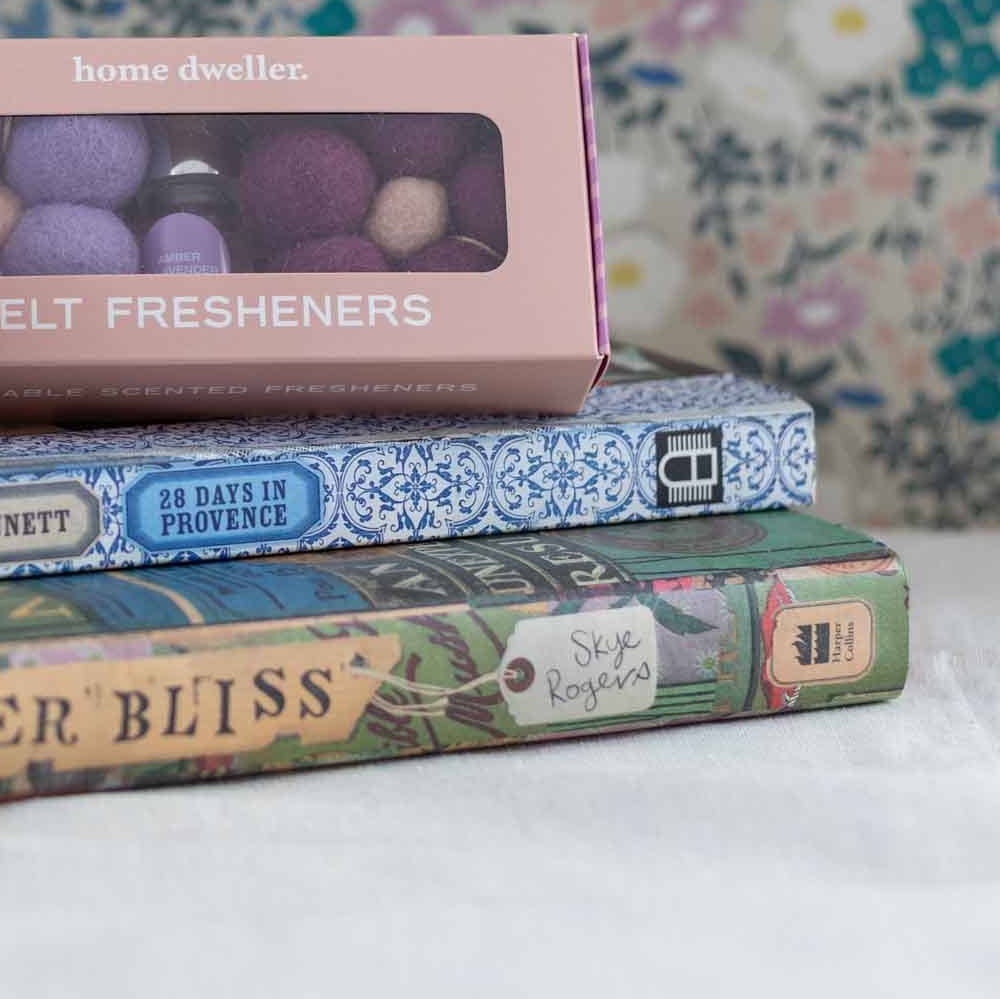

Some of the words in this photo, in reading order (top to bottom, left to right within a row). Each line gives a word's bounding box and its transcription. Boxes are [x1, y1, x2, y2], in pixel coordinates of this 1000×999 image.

[72, 55, 169, 83] home
[177, 53, 310, 81] dweller.
[106, 293, 433, 330] FRESHENERS
[100, 384, 249, 398] SCENTED
[263, 382, 479, 394] FRESHENERS
[159, 487, 186, 510] 28
[194, 481, 254, 507] DAYS
[261, 479, 287, 501] IN
[160, 503, 288, 537] PROVENCE
[570, 629, 641, 671] Skye
[831, 623, 844, 663] Harper
[843, 621, 855, 662] Collins
[112, 666, 334, 743] BLISS
[545, 661, 651, 712] Rogers
